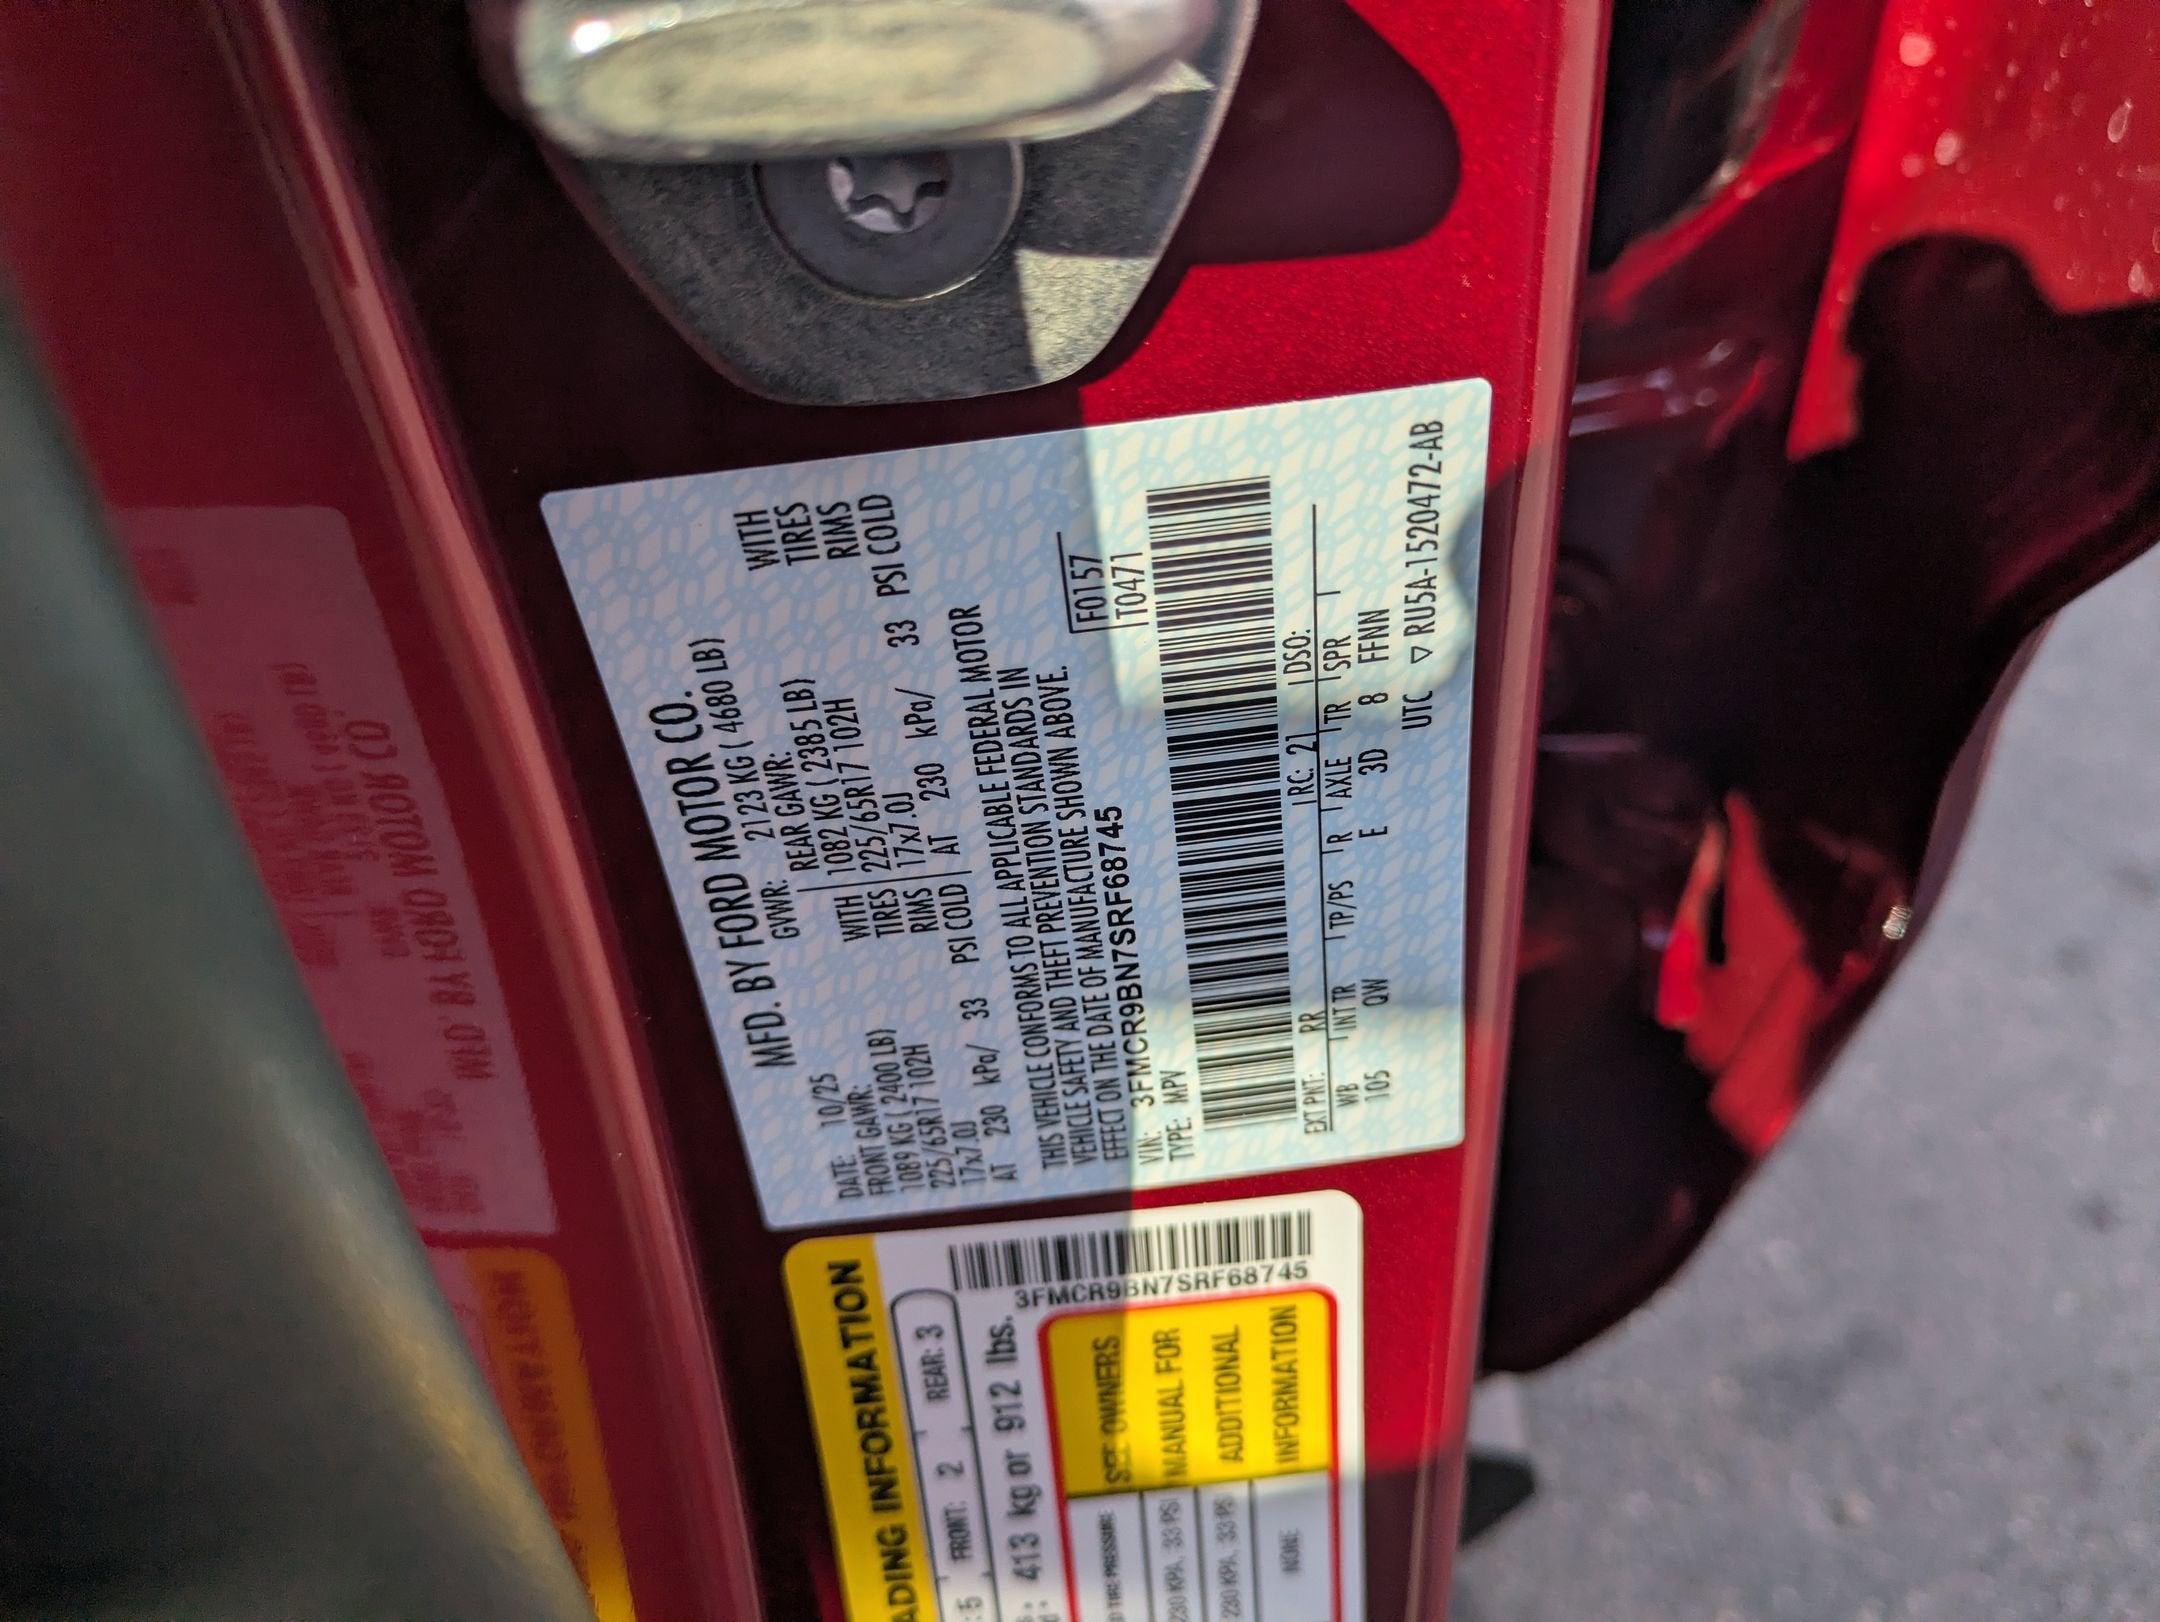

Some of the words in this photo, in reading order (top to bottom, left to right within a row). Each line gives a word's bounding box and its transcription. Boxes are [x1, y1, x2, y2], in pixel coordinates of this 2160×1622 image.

[734, 509, 780, 570] WITH
[773, 502, 819, 565] TIRES
[816, 501, 860, 559] RIMS
[858, 494, 900, 554] COLD
[1404, 421, 1442, 635] RU5A-1520472-AB
[871, 562, 910, 596] PSI
[1068, 554, 1108, 622] F0157
[1110, 552, 1147, 618] T0471
[688, 637, 728, 672] LB)
[884, 619, 919, 647] 33
[948, 605, 991, 682] MOTOR
[1282, 629, 1311, 674] DSO:
[1322, 635, 1351, 671] SPR
[1357, 608, 1389, 663] FFNN
[780, 678, 818, 712] LB)
[996, 666, 1030, 689] IN
[1357, 692, 1388, 705] 8
[648, 691, 703, 742] CO.
[701, 680, 743, 732] 4680
[822, 698, 863, 751] 102H
[895, 687, 937, 738] kPa/
[1036, 666, 1075, 737] ABOVE.
[1323, 700, 1351, 724] TR
[1401, 690, 1432, 729] UTC
[789, 719, 832, 771] 2385
[964, 688, 1006, 775] FEDERAL
[1284, 731, 1317, 754] 21
[723, 755, 759, 784] KG
[1002, 697, 1048, 813] STANDARDS
[1324, 756, 1352, 797] AXLE
[1357, 748, 1388, 775] 3D
[763, 752, 804, 816] GAWR:
[913, 762, 950, 800] 230
[1047, 746, 1085, 820] SHOWN
[1286, 767, 1314, 796] RC:
[666, 753, 739, 860] MOTOR
[733, 789, 775, 840] 2123
[809, 793, 844, 820] KG
[837, 762, 890, 871] 225/65R17
[882, 792, 925, 867] 17x7.0J
[780, 822, 819, 871] REAR
[817, 826, 855, 875] 1082
[927, 834, 960, 854] AT
[979, 781, 1024, 890] APPLICABLE
[1326, 831, 1353, 843] R
[1358, 825, 1387, 838] E
[1021, 821, 1064, 933] PREVENTION
[1058, 826, 1103, 959] MANUFACTURE
[703, 873, 763, 948] FORD
[760, 879, 799, 939] GVWR:
[834, 894, 870, 941] WITH
[867, 888, 904, 937] TIRES
[902, 887, 938, 932] RIMS
[938, 883, 972, 929] COLD
[999, 895, 1031, 927] ALL
[1327, 880, 1356, 929] TP/PS
[947, 935, 979, 963] PSI
[1005, 935, 1035, 958] TO
[1039, 940, 1073, 989] THEFT
[1095, 807, 1153, 1108] 3FMCR9BN7SRF68745
[725, 960, 775, 992] BY
[1077, 966, 1107, 987] OF
[1331, 983, 1356, 1002] TR
[1361, 978, 1389, 1006] QW
[959, 997, 989, 1020] 33
[1010, 962, 1050, 1057] CONFORMS
[1048, 996, 1079, 1030] AND
[1081, 992, 1113, 1036] DATE
[1298, 1009, 1325, 1032] RR
[1331, 1006, 1357, 1030] INT
[743, 1002, 795, 1066] MFD.
[865, 1028, 897, 1056] LB)
[1088, 1040, 1118, 1073] THE
[873, 1061, 907, 1104] 2400
[901, 1043, 935, 1087] 102H
[965, 1043, 1000, 1085] kPa/
[1054, 1039, 1088, 1096] SAFETY
[1160, 1070, 1188, 1103] MPV
[1363, 1069, 1390, 1101] 105
[809, 1073, 846, 1127] 10/25
[847, 1084, 881, 1138] GAWR:
[1026, 1062, 1060, 1128] VEHICLE
[1093, 1077, 1122, 1102] ON
[1301, 1072, 1325, 1105] PNT:
[1335, 1083, 1359, 1107] WB
[887, 1122, 915, 1145] KG
[911, 1096, 959, 1188] 225/65R17
[980, 1104, 1010, 1136] 230
[1064, 1100, 1097, 1164] VEHICLE
[1096, 1108, 1129, 1160] EFFECT
[1165, 1117, 1193, 1161] TYPE:
[1303, 1110, 1328, 1134] EXT
[859, 1145, 894, 1195] FRONT
[950, 1120, 985, 1184] 17x7.0J
[1037, 1132, 1067, 1169] THIS
[1135, 1131, 1163, 1164] VIN:
[830, 1154, 863, 1199] DATE:
[893, 1151, 924, 1191] 1089
[989, 1163, 1017, 1181] AT
[914, 1324, 944, 1340] 3
[985, 1315, 1016, 1363] lbs.
[1152, 1328, 1181, 1374] FOR
[830, 1261, 898, 1510] INFORMATION
[920, 1348, 948, 1401] REAR:
[1092, 1335, 1126, 1435] OWNERS
[1213, 1327, 1243, 1461] ADDITIONAL
[1270, 1305, 1299, 1462] INFORMATION
[988, 1380, 1025, 1431] 912
[1158, 1380, 1186, 1478] MANUAL
[935, 1460, 964, 1477] 2
[1005, 1449, 1031, 1476] or
[1006, 1486, 1041, 1518] kg
[944, 1500, 970, 1561] FRONT:
[1008, 1532, 1041, 1581] 413
